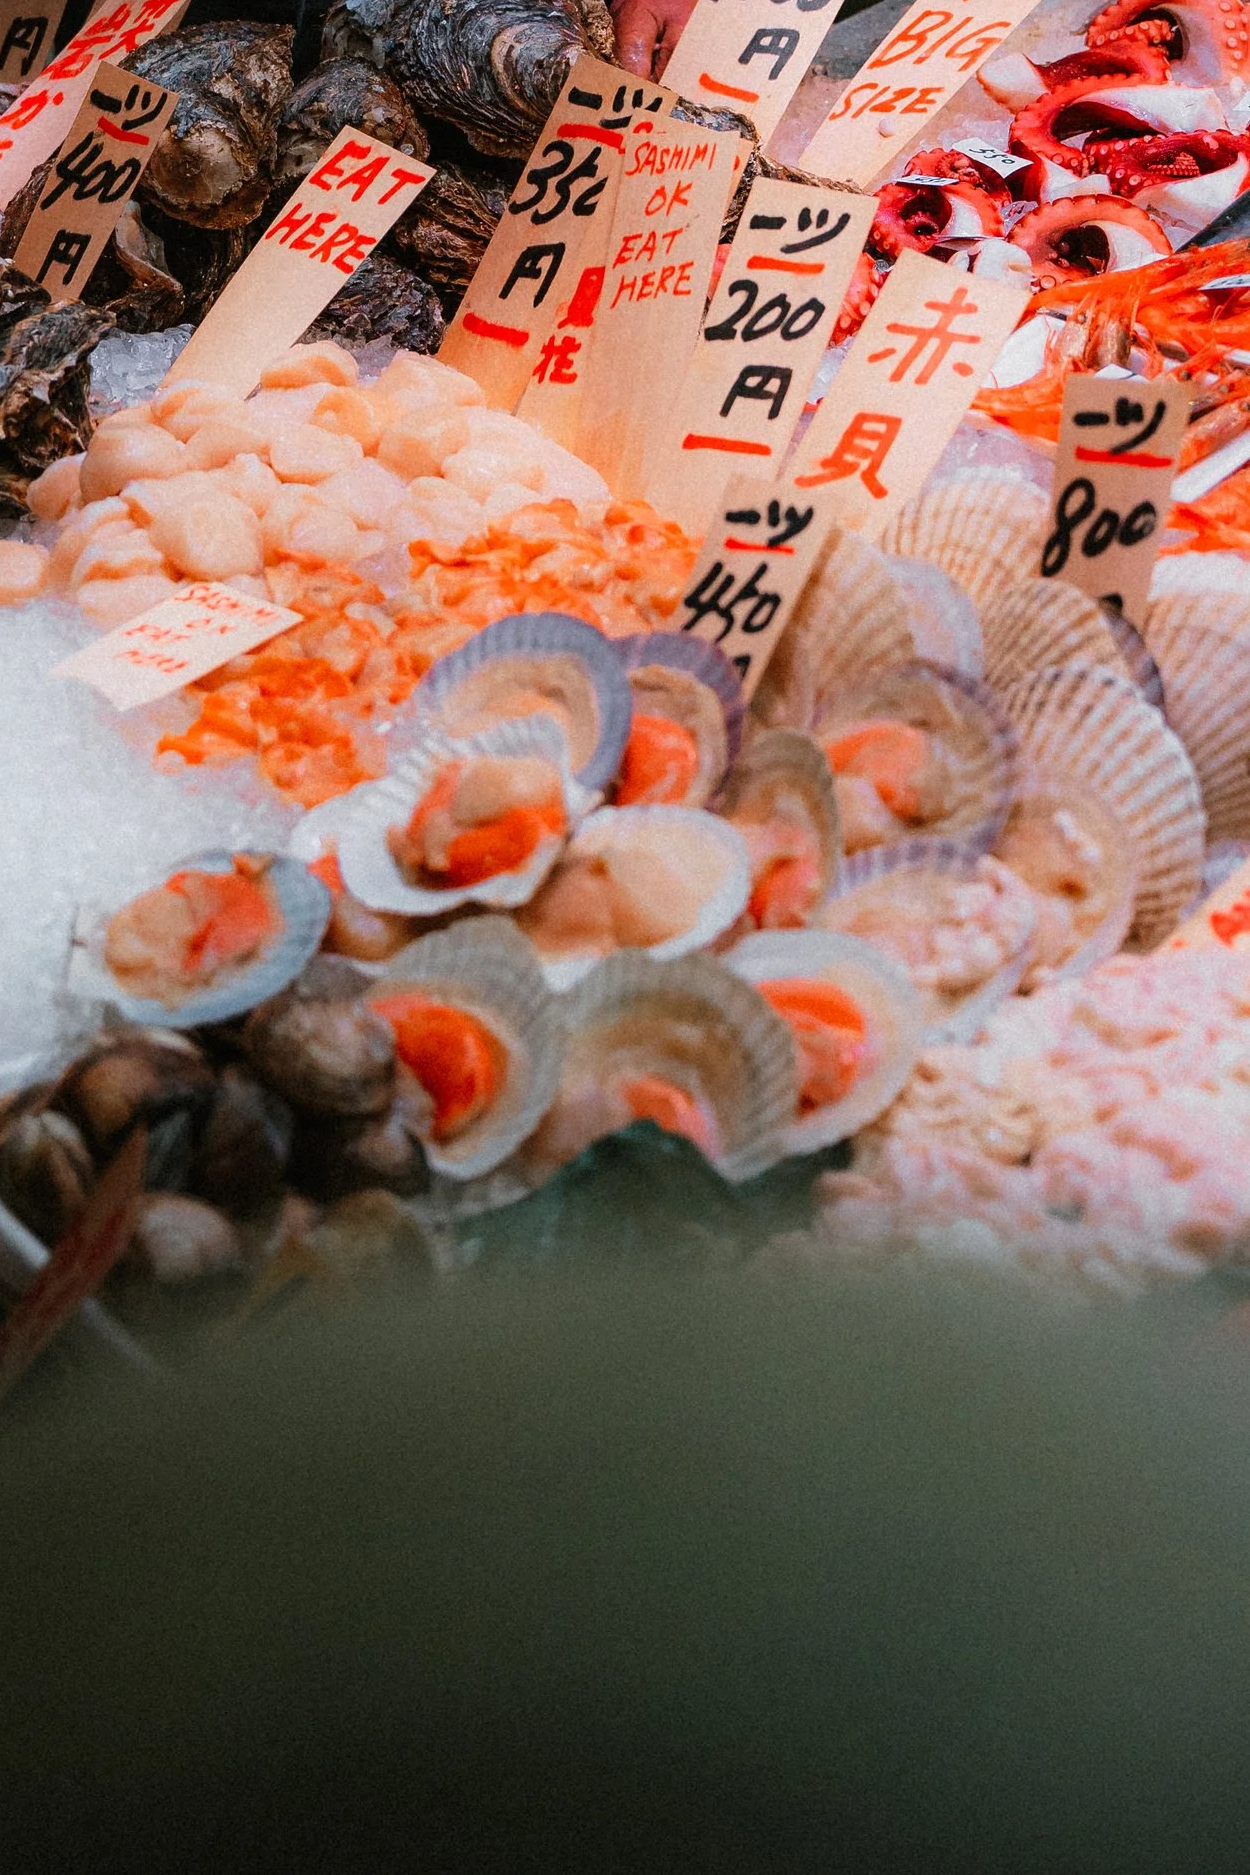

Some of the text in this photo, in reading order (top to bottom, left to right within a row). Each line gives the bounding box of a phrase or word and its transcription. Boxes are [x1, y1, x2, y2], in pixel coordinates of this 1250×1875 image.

[737, 27, 801, 81] 円
[867, 9, 1013, 73] BIG
[828, 81, 948, 122] SIZE
[40, 131, 143, 211] 400
[308, 140, 427, 206] EAT
[624, 141, 718, 177] SASHIMI
[968, 147, 1016, 165] 550
[644, 182, 693, 218] OK
[36, 227, 94, 286] 円
[264, 202, 378, 275] HERE
[612, 228, 684, 269] EAT
[498, 241, 566, 308] 円
[610, 261, 695, 309] HERE
[703, 279, 826, 343] 200
[719, 364, 793, 421] 円
[793, 286, 982, 500] 赤貝
[1040, 477, 1158, 578] 800
[681, 560, 783, 643] 450
